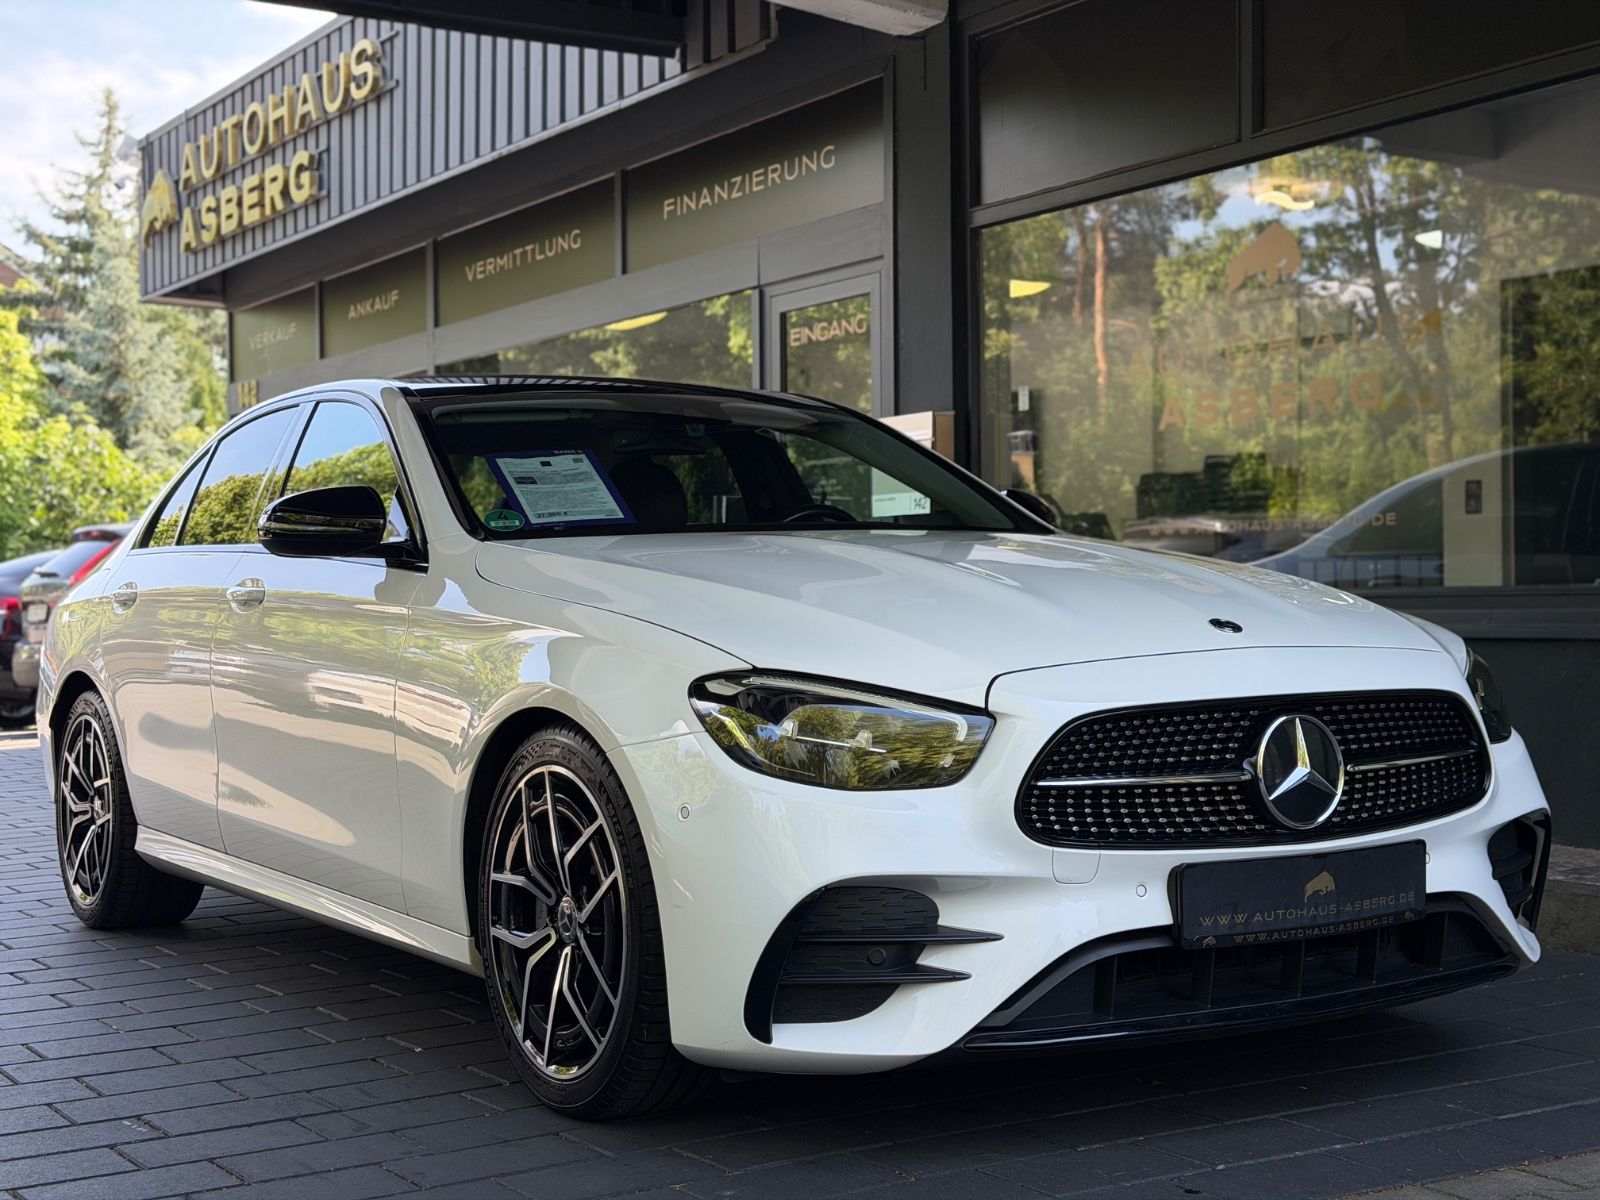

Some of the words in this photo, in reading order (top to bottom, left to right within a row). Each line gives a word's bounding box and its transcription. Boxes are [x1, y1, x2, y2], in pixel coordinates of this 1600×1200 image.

[179, 38, 380, 193] AUTOHAUS
[180, 150, 317, 253] ASBERG
[663, 145, 836, 220] FINANZIERUNG
[465, 229, 582, 282] VERMITTLUNG
[348, 290, 399, 320] ANKAUF
[789, 314, 868, 346] EINGANG
[248, 322, 297, 350] VERKAUF
[1125, 306, 1428, 381] AUTOHAUS
[1159, 372, 1384, 431] ASBERG
[1200, 892, 1415, 927] WWW.AUTOHAUS-ASBERG.DE
[1234, 915, 1395, 944] WWW.AUTOHAUS-ASBERG.DE
